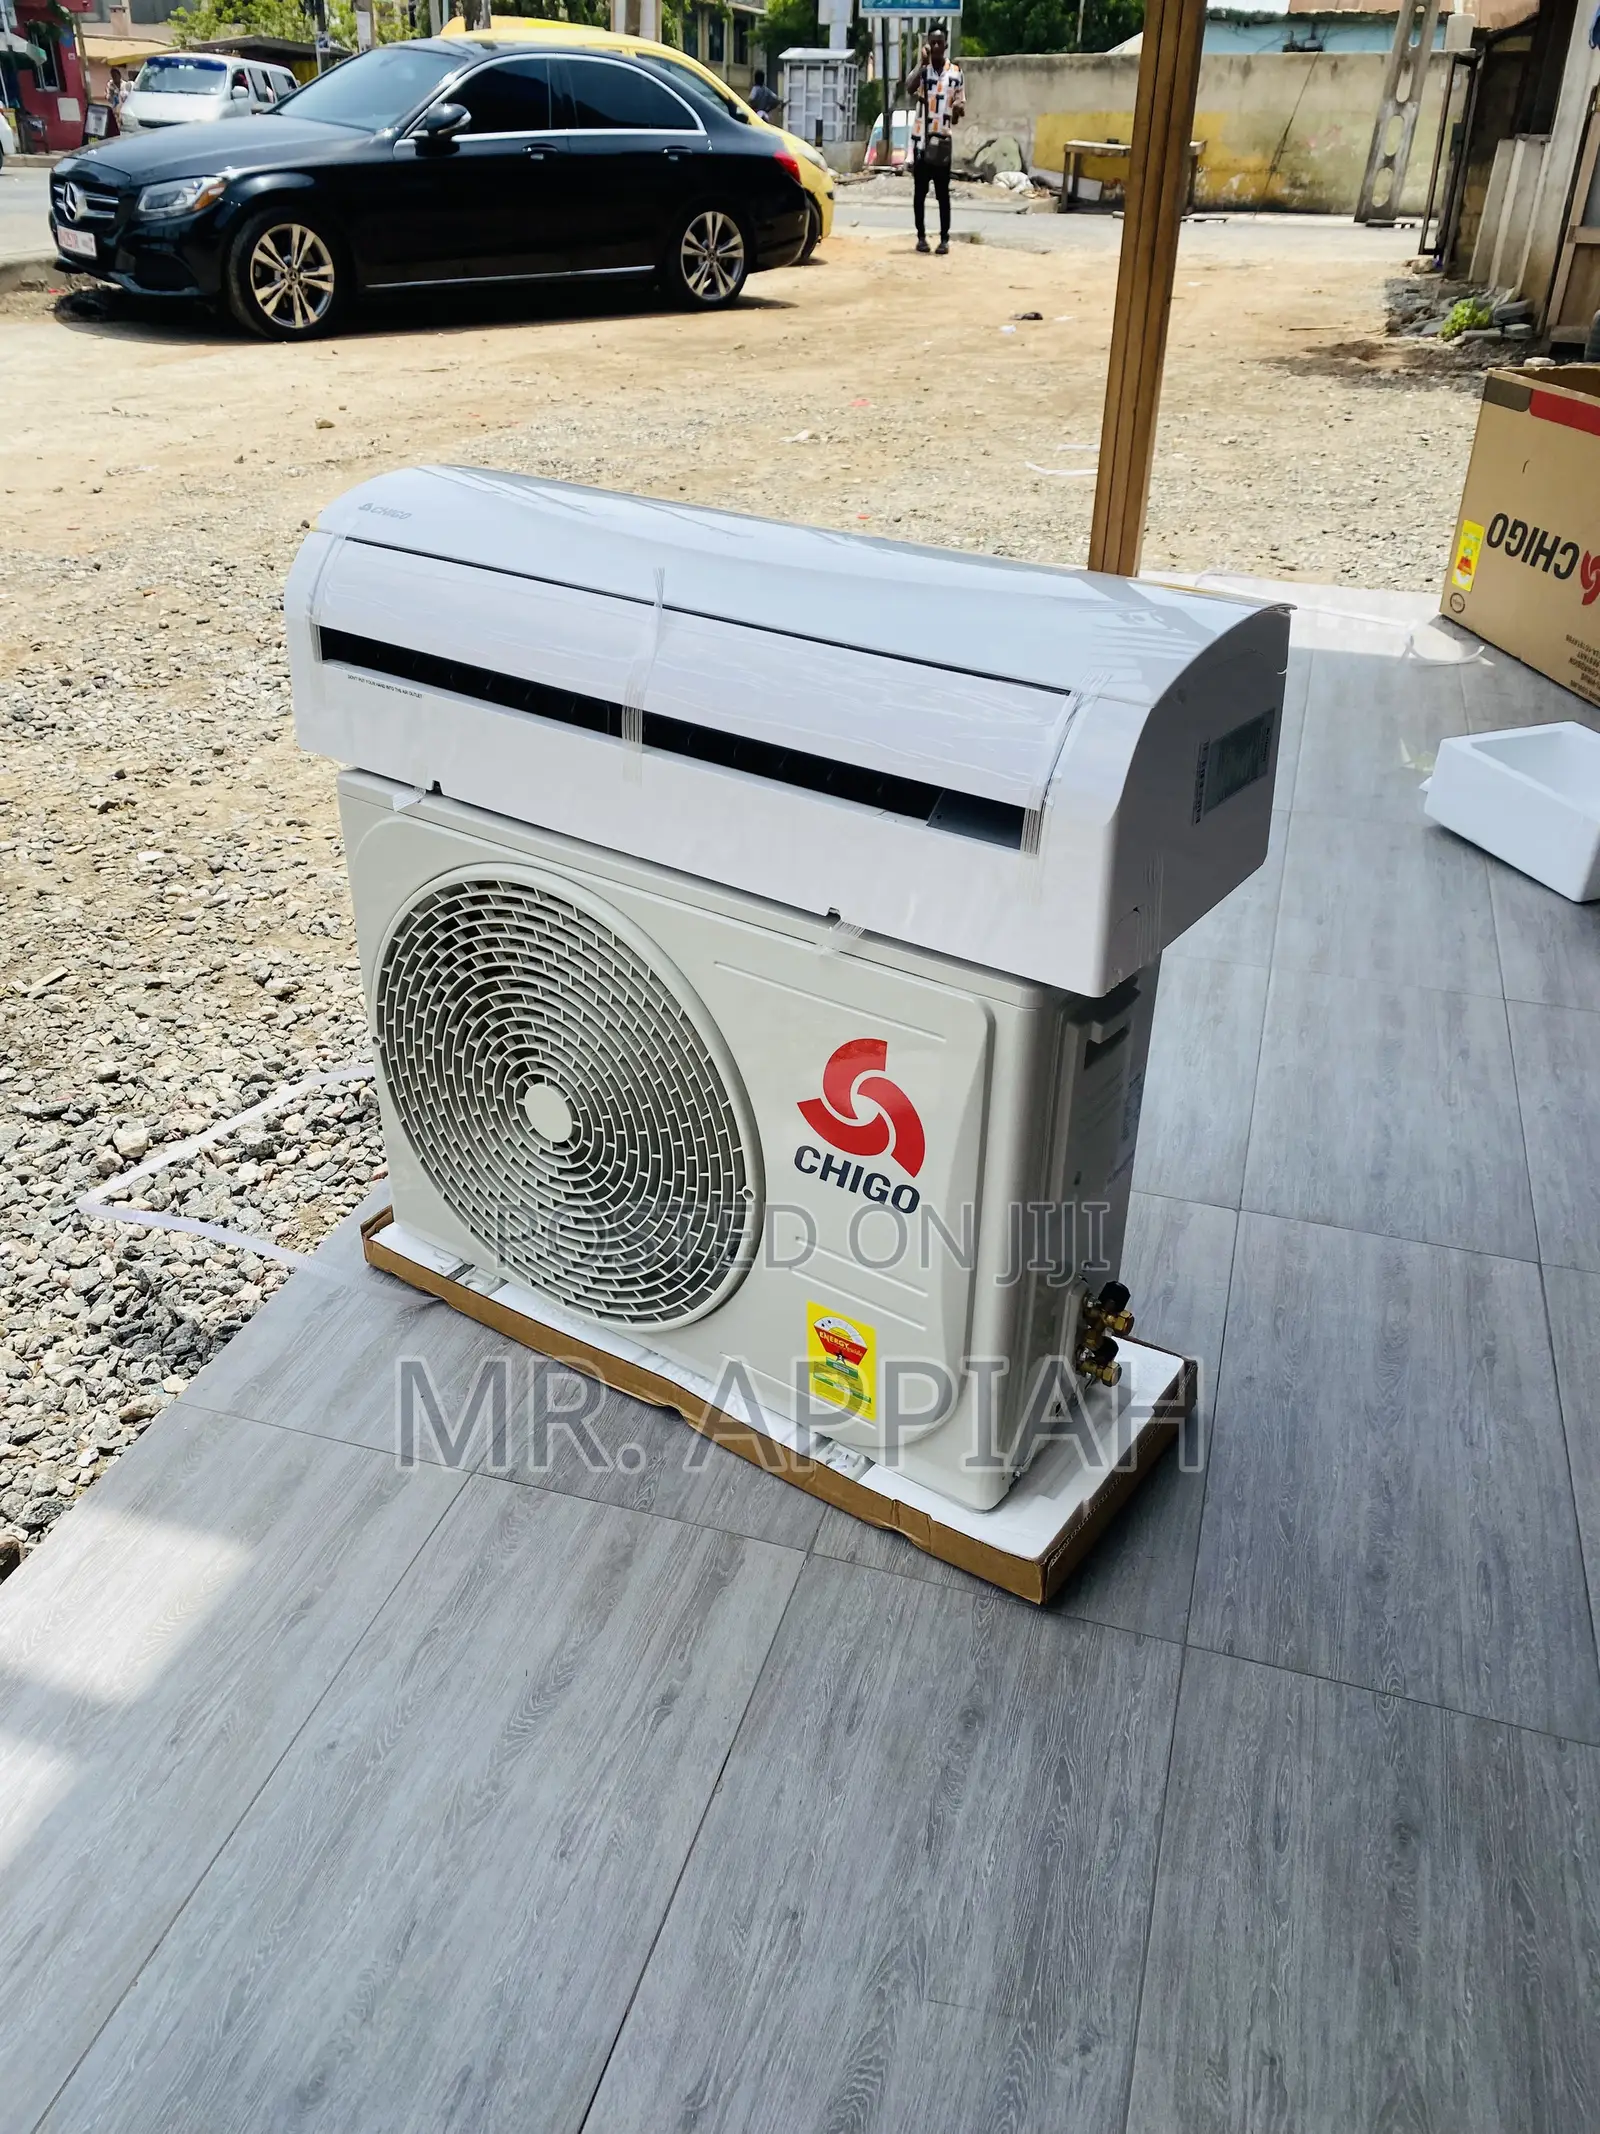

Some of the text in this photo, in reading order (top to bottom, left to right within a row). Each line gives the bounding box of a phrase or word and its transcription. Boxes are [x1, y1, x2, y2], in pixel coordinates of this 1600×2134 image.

[370, 506, 412, 519] CHIGO
[1486, 512, 1580, 580] CHIGO
[793, 1145, 921, 1214] CHIGO
[820, 1331, 850, 1349] ENERGY
